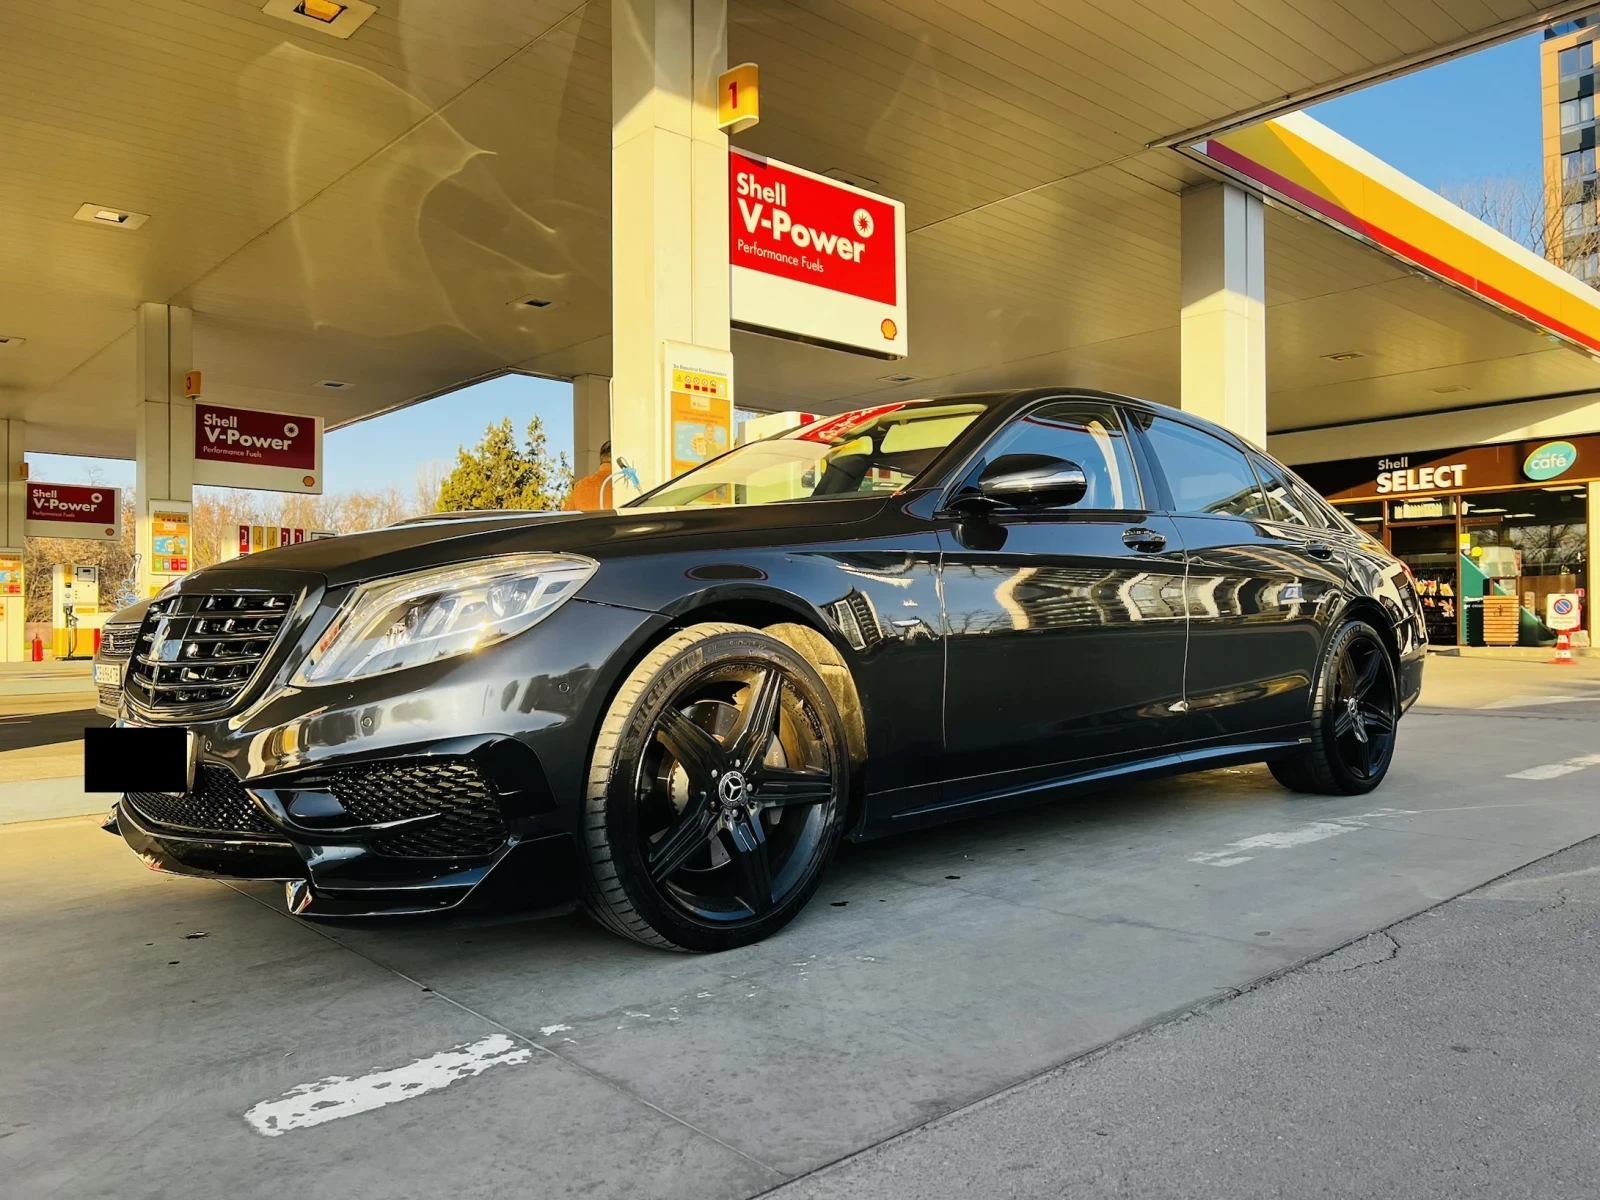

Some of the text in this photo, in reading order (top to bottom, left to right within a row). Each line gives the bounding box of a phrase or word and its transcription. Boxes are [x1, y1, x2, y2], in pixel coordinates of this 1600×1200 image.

[728, 81, 738, 110] 1
[737, 172, 786, 207] Shell
[737, 197, 865, 263] V-Power
[737, 238, 824, 273] Performance Fuels
[186, 376, 192, 390] 3
[204, 413, 237, 428] Shell
[204, 426, 292, 450] V-Power
[203, 445, 262, 458] Performance Fuels
[1378, 456, 1408, 470] Shell
[1531, 453, 1567, 470] café
[1376, 464, 1467, 493] SELECT
[32, 488, 57, 498] Shell
[33, 498, 98, 512] V-Power
